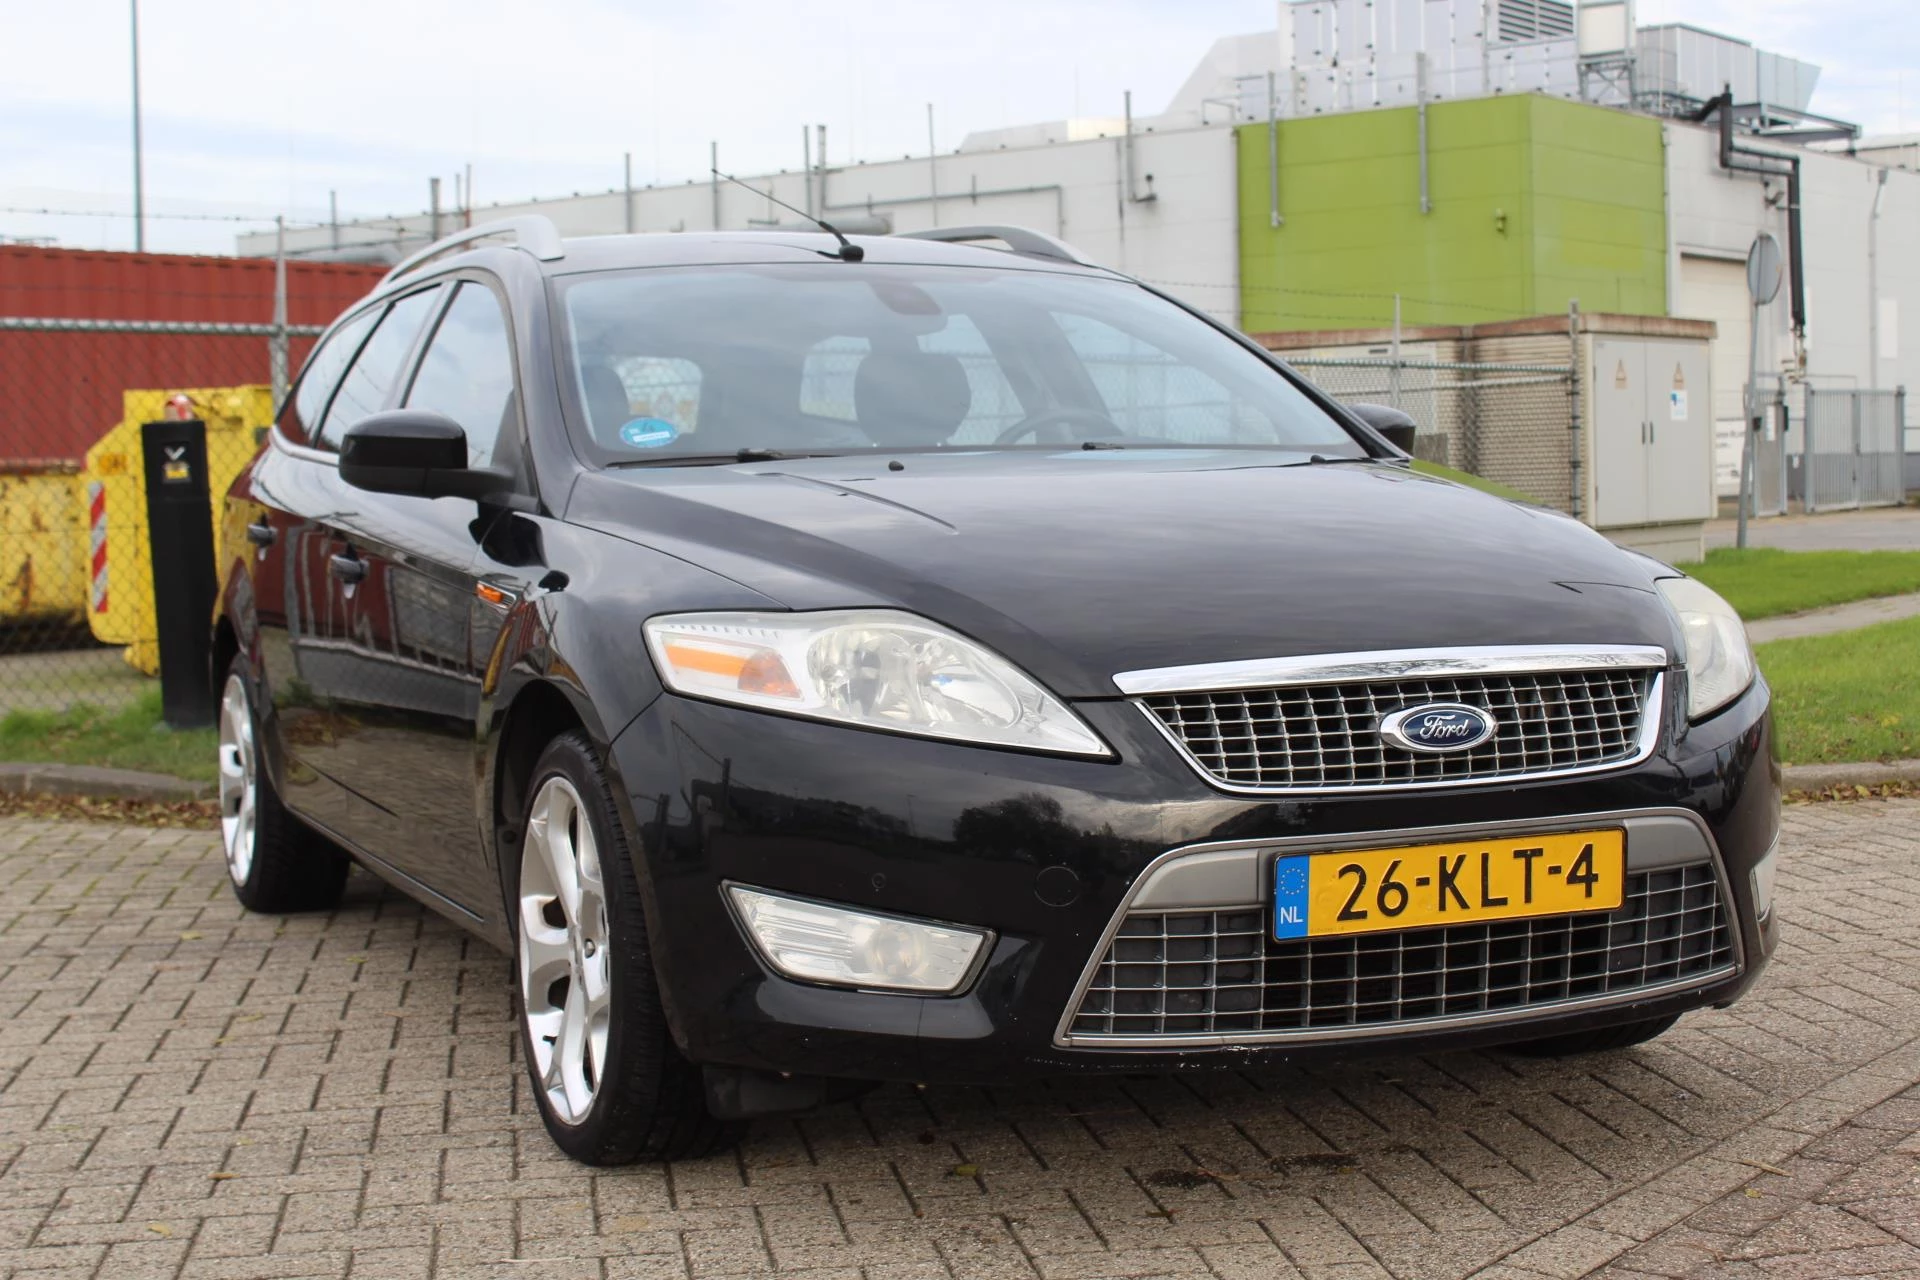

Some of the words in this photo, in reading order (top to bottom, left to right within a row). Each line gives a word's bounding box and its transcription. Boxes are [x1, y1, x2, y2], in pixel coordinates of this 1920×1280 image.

[1420, 714, 1470, 739] Ford
[1336, 843, 1599, 922] 26-KLT-4
[1280, 906, 1304, 924] NL
